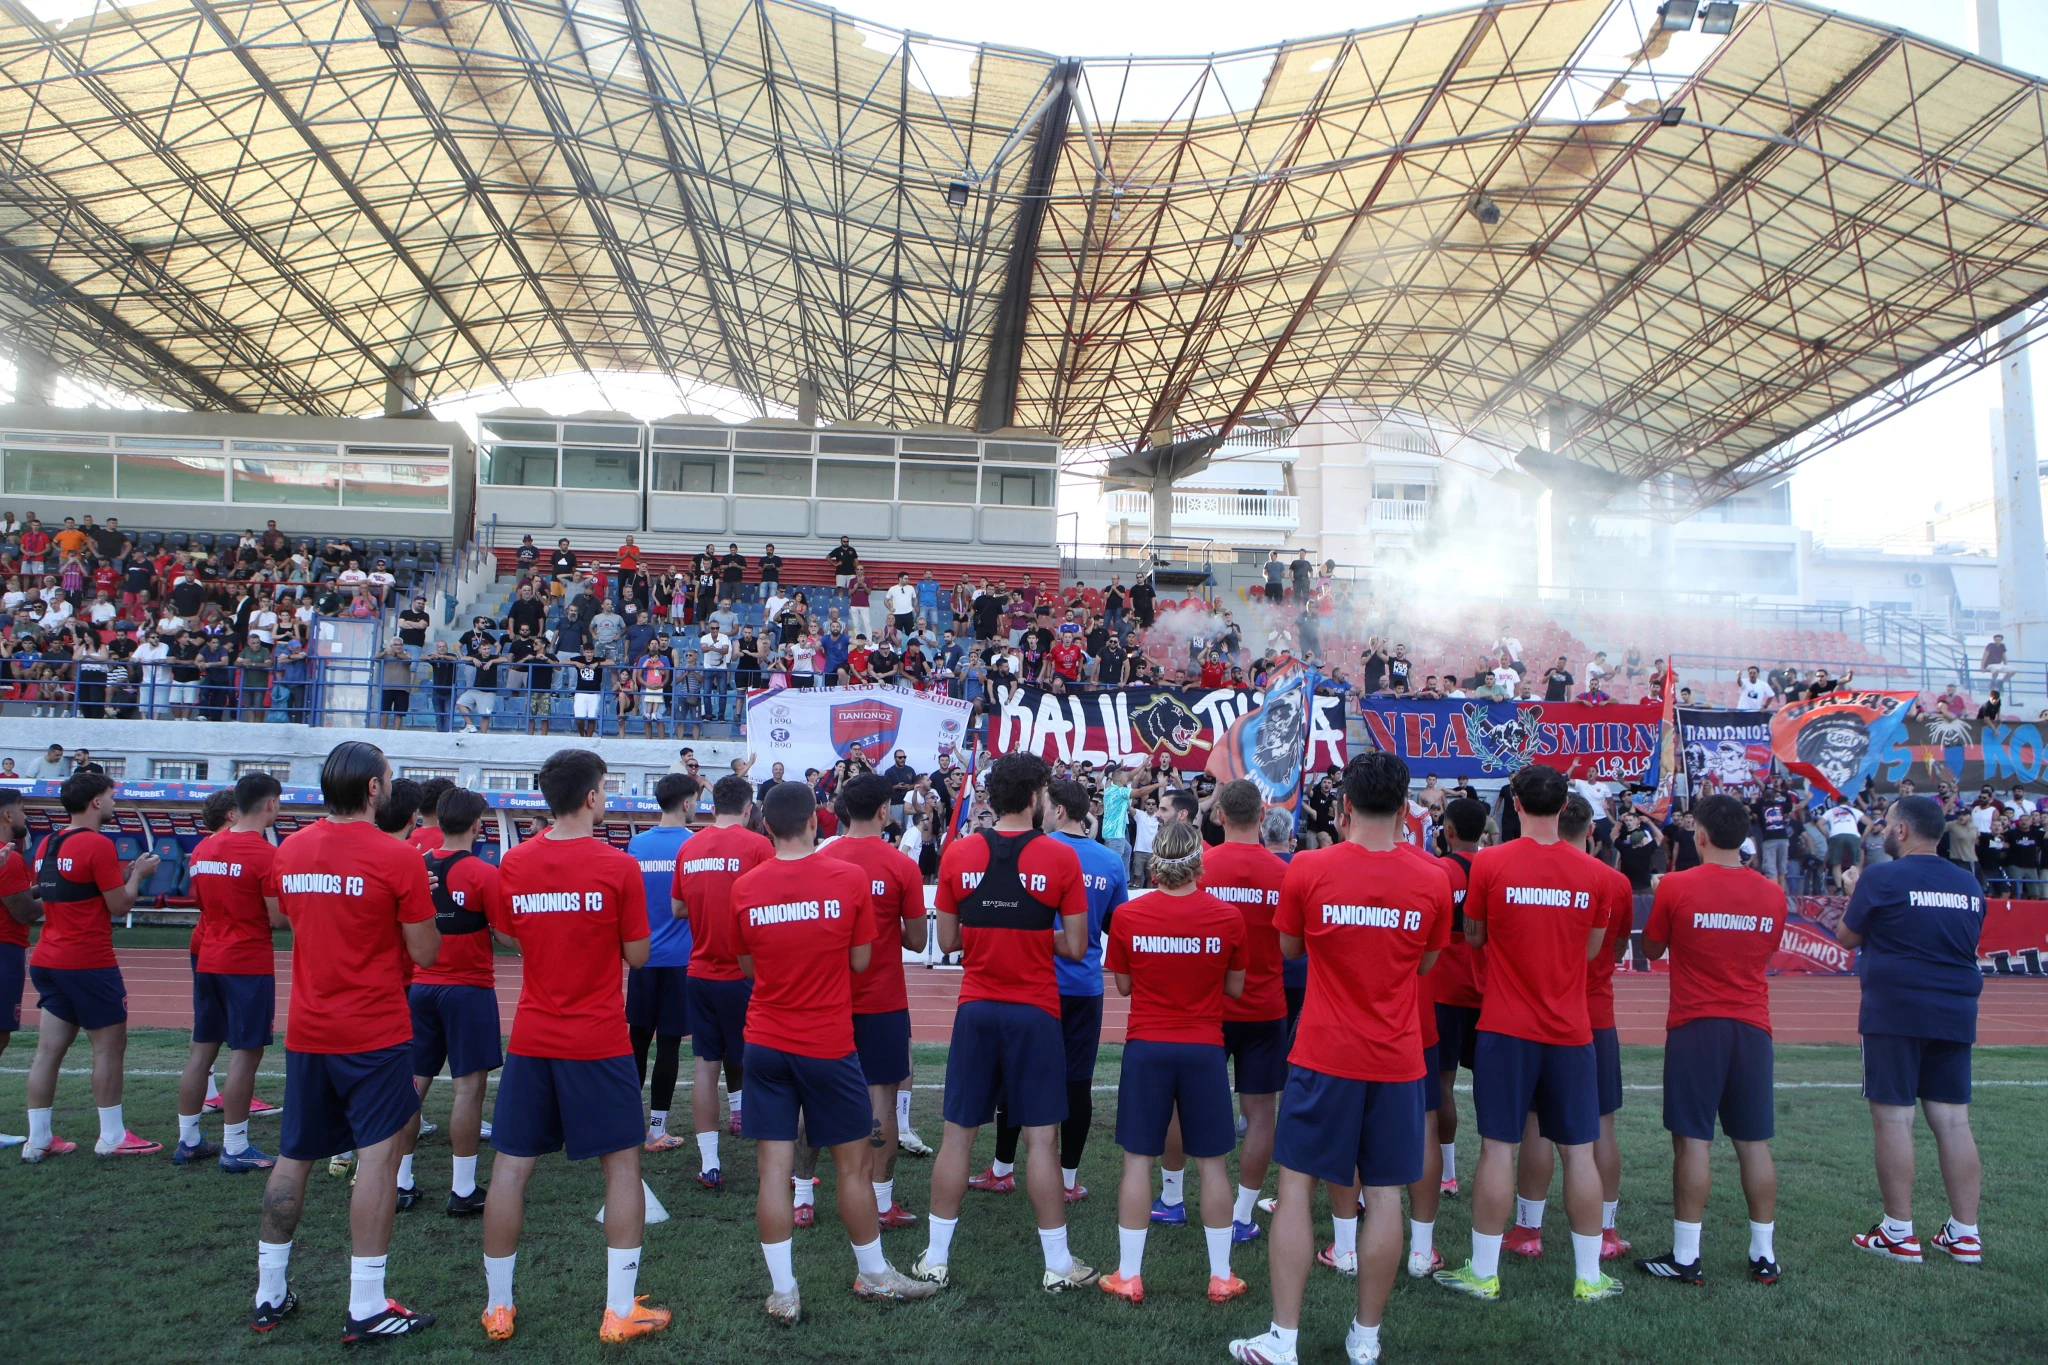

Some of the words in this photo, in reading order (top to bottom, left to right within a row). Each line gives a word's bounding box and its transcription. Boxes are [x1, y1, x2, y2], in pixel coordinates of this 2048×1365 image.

[914, 691, 969, 709] School
[769, 717, 792, 726] 1890
[838, 711, 893, 722] ΠΑΝΙΩΝΙΟΣ
[937, 730, 960, 741] 1947
[1192, 688, 1345, 771] TA
[1361, 709, 1477, 759] NEA
[1536, 722, 1657, 756] SMIRN
[1686, 723, 1770, 742] ΠΑΝΙΩΝΙΟΣ
[769, 741, 792, 749] 1890
[1980, 723, 2048, 785] KO
[123, 789, 166, 798] SUPERBET
[510, 798, 549, 807] SUPERBE
[62, 857, 73, 872] FC
[230, 863, 242, 877] FC
[683, 857, 725, 875] PANIONIOS
[727, 858, 740, 872] FC
[345, 876, 364, 896] FC
[871, 880, 885, 896] FC
[1030, 874, 1047, 892] FC
[1094, 876, 1107, 891] FC
[452, 890, 465, 906] FC
[511, 892, 581, 914] PANIONIOS
[584, 892, 603, 912] FC
[1266, 890, 1280, 906] FC
[1506, 886, 1571, 908] PANIONIOS
[1574, 891, 1590, 910] FC
[1909, 890, 1969, 910] PANIONIOS
[1970, 896, 1980, 913] FC
[749, 900, 820, 927] PANIONIOS
[823, 899, 840, 919] FC
[1322, 904, 1400, 929] PANIONIOS
[1403, 910, 1422, 931] FC
[1693, 912, 1757, 931] PANIONIOS
[1759, 916, 1774, 933] FC
[1132, 935, 1201, 954] PANIONIOS
[1205, 937, 1221, 954] FC
[1780, 928, 1849, 971] ΝΙΩΝΙΟΣ
